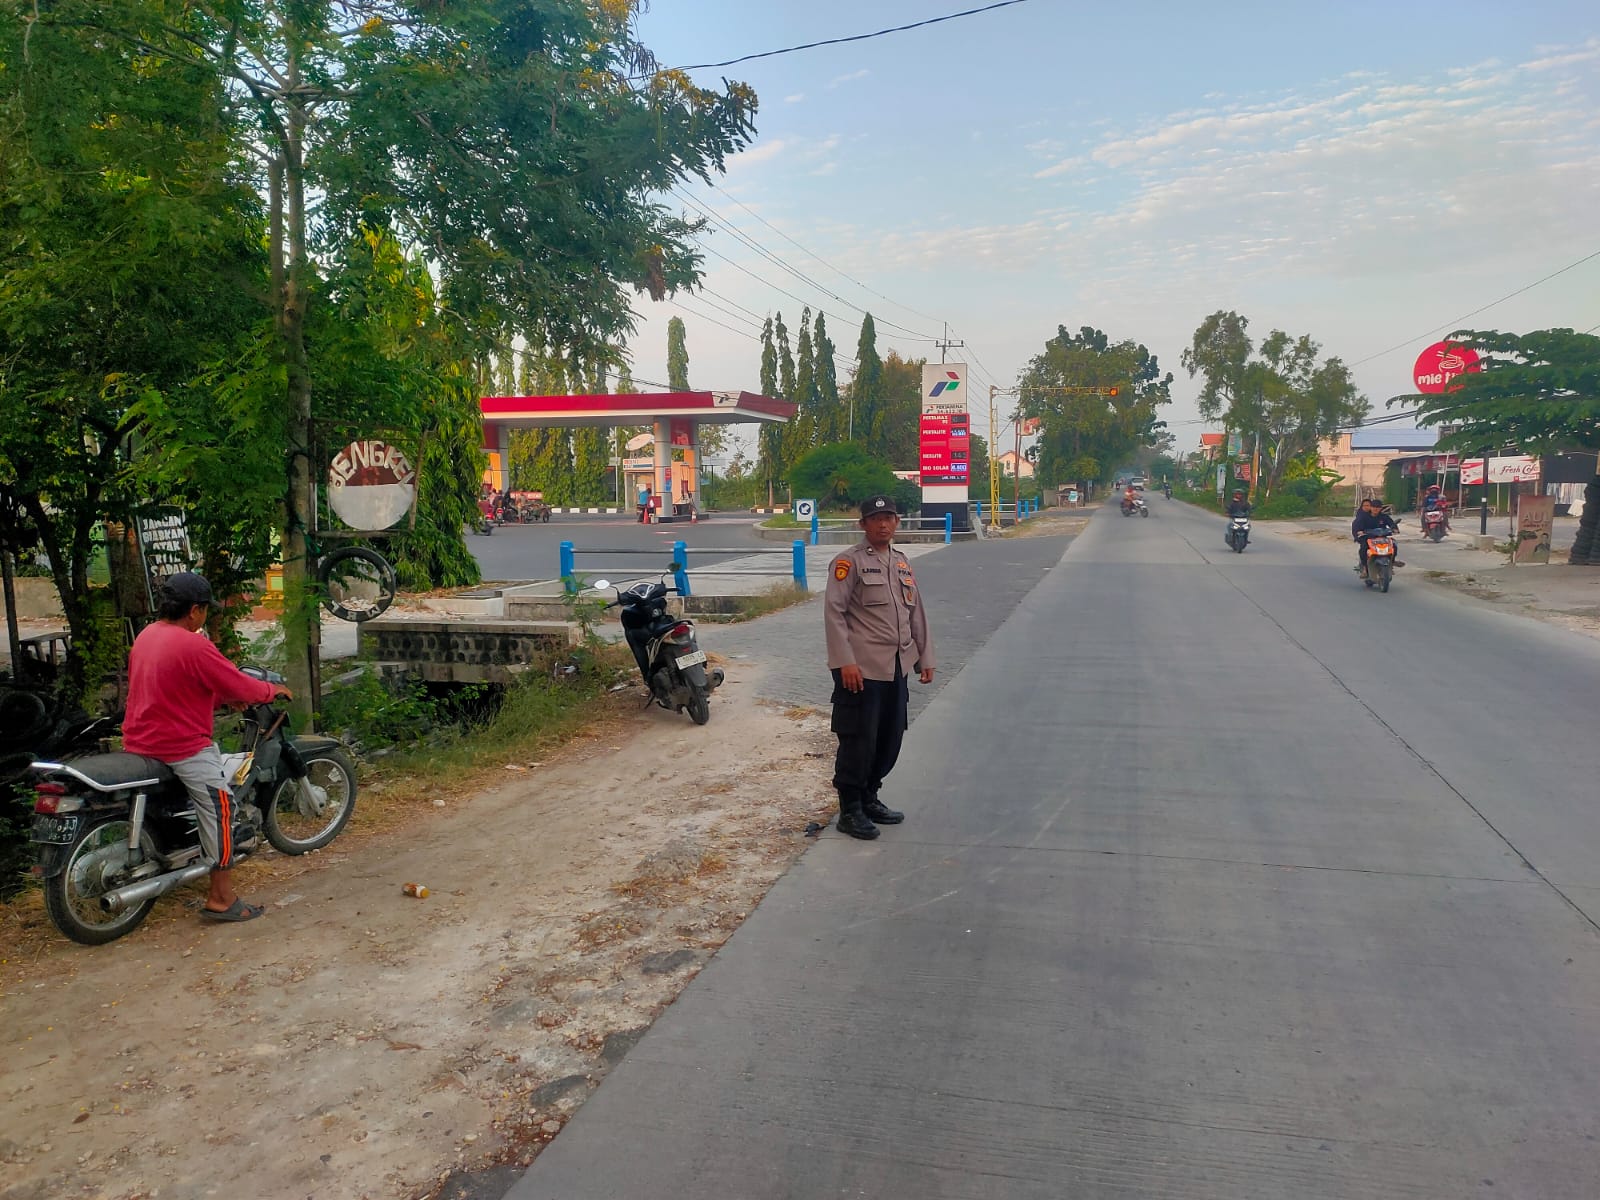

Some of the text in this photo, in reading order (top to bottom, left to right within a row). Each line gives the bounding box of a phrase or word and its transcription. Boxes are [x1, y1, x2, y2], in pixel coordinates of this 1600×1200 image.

[1418, 373, 1442, 385] mie
[329, 439, 415, 493] BENGKEL
[1500, 465, 1521, 475] Fresh
